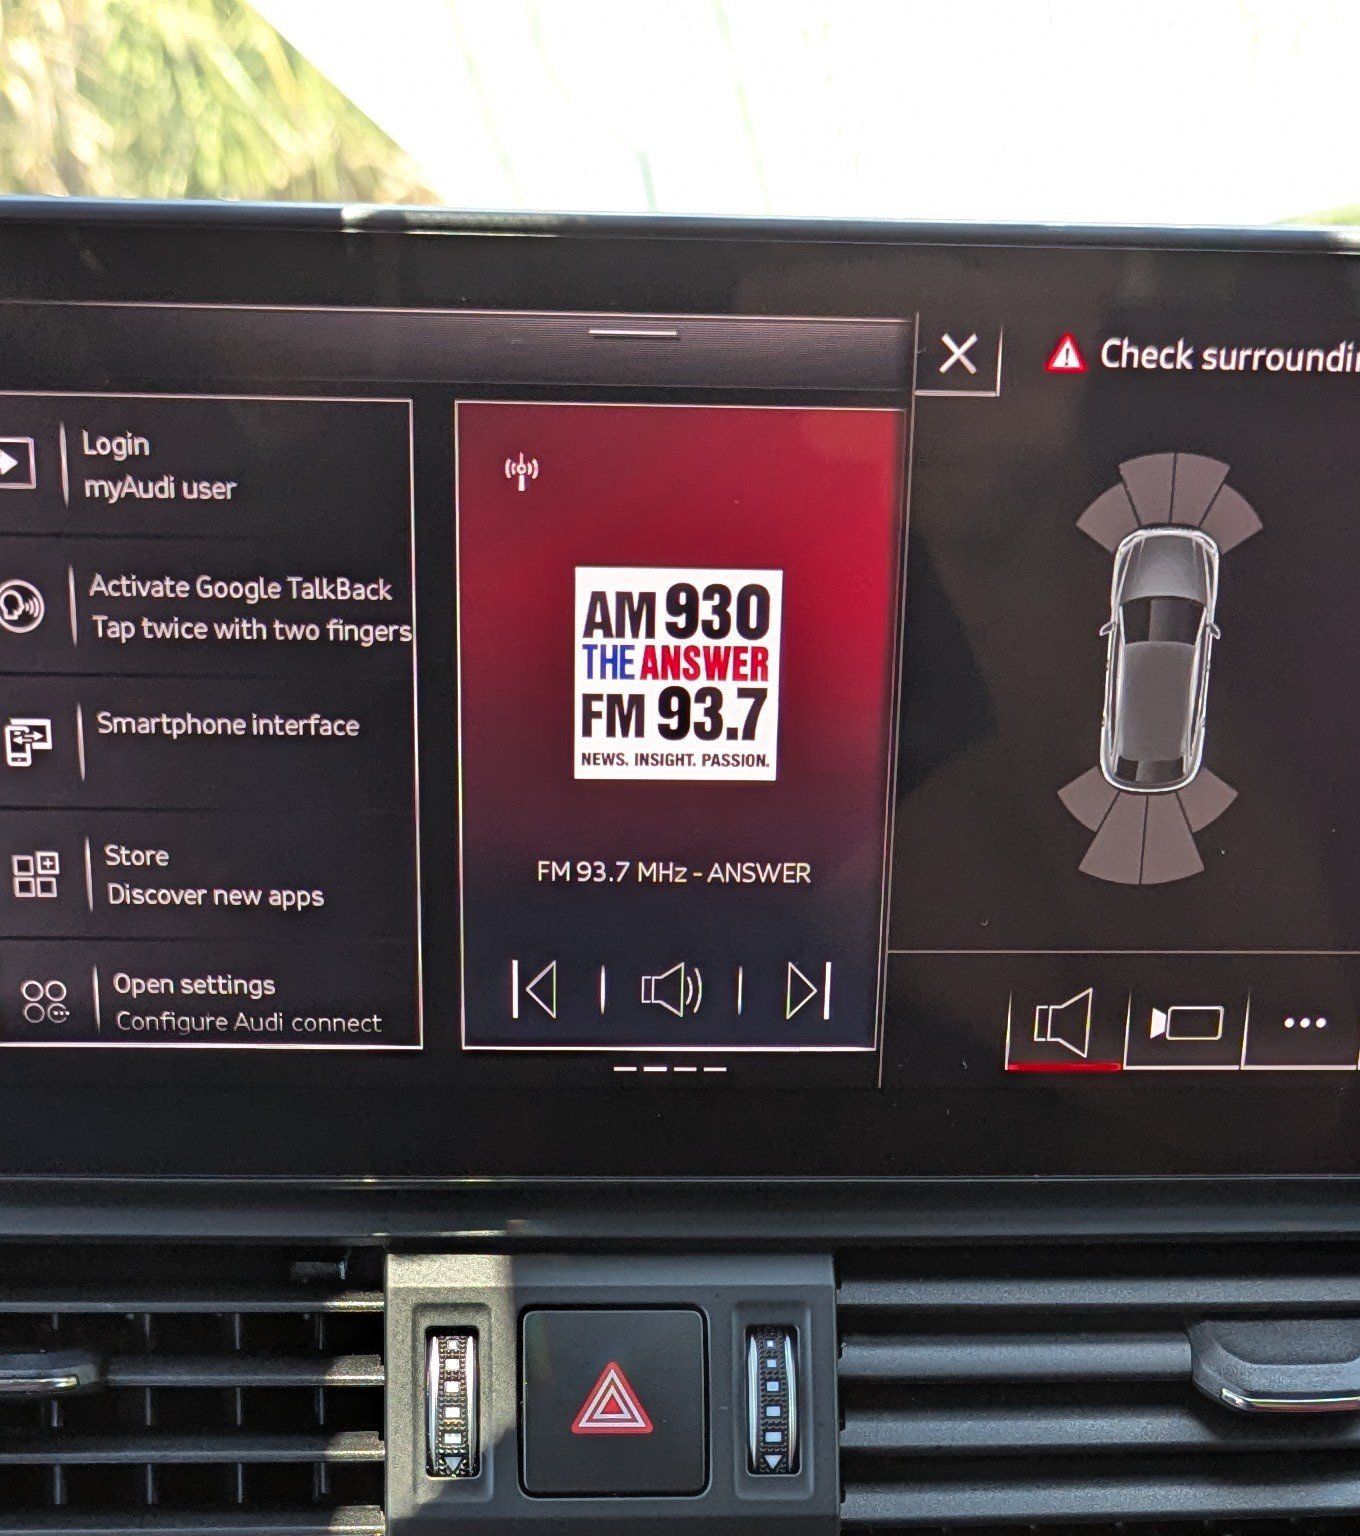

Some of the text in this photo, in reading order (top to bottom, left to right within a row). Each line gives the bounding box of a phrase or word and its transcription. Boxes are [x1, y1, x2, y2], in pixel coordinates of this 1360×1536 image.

[1100, 337, 1193, 371] Check
[82, 431, 150, 458] Login
[84, 475, 237, 503] myAudi user
[89, 576, 392, 606] Activate Google TalkBack
[582, 582, 771, 640] AM 930
[92, 617, 413, 647] Tap twice with two fingers
[582, 644, 769, 682] THE ANSWER
[97, 712, 360, 742] Smartphone interface
[581, 686, 768, 741] FM 93.7
[581, 753, 770, 768] NEWS. INSIGHT. PASSION.
[104, 844, 170, 868] Store
[537, 861, 571, 882] FM
[576, 861, 630, 882] 93.7
[638, 862, 687, 883] MHz
[706, 862, 811, 884] ANSWER
[108, 883, 324, 911] Discover new apps
[113, 974, 276, 1001] Open settings
[116, 1010, 383, 1037] Configure Audi connect
